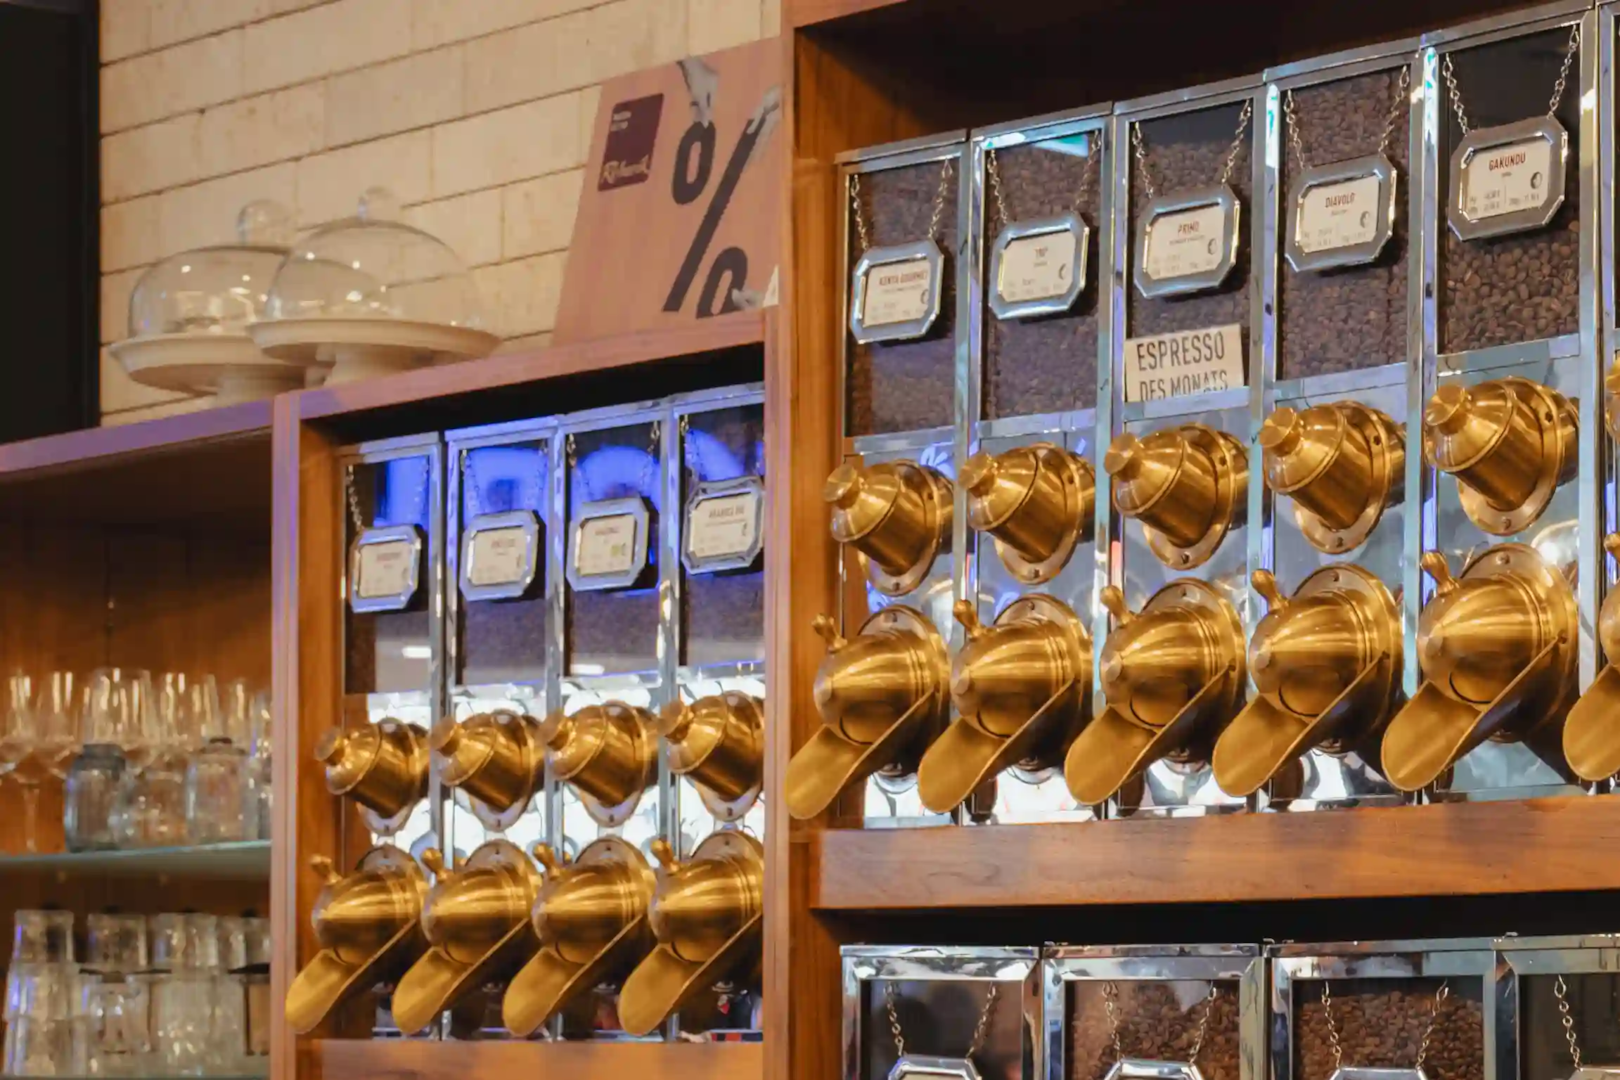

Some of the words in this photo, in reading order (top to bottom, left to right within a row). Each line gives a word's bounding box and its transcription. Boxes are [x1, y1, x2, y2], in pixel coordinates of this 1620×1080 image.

[1488, 151, 1526, 172] GAKUNDU
[1325, 191, 1355, 209] DIAVOLO
[1136, 330, 1225, 371] ESPRESSO
[1140, 378, 1166, 401] DES
